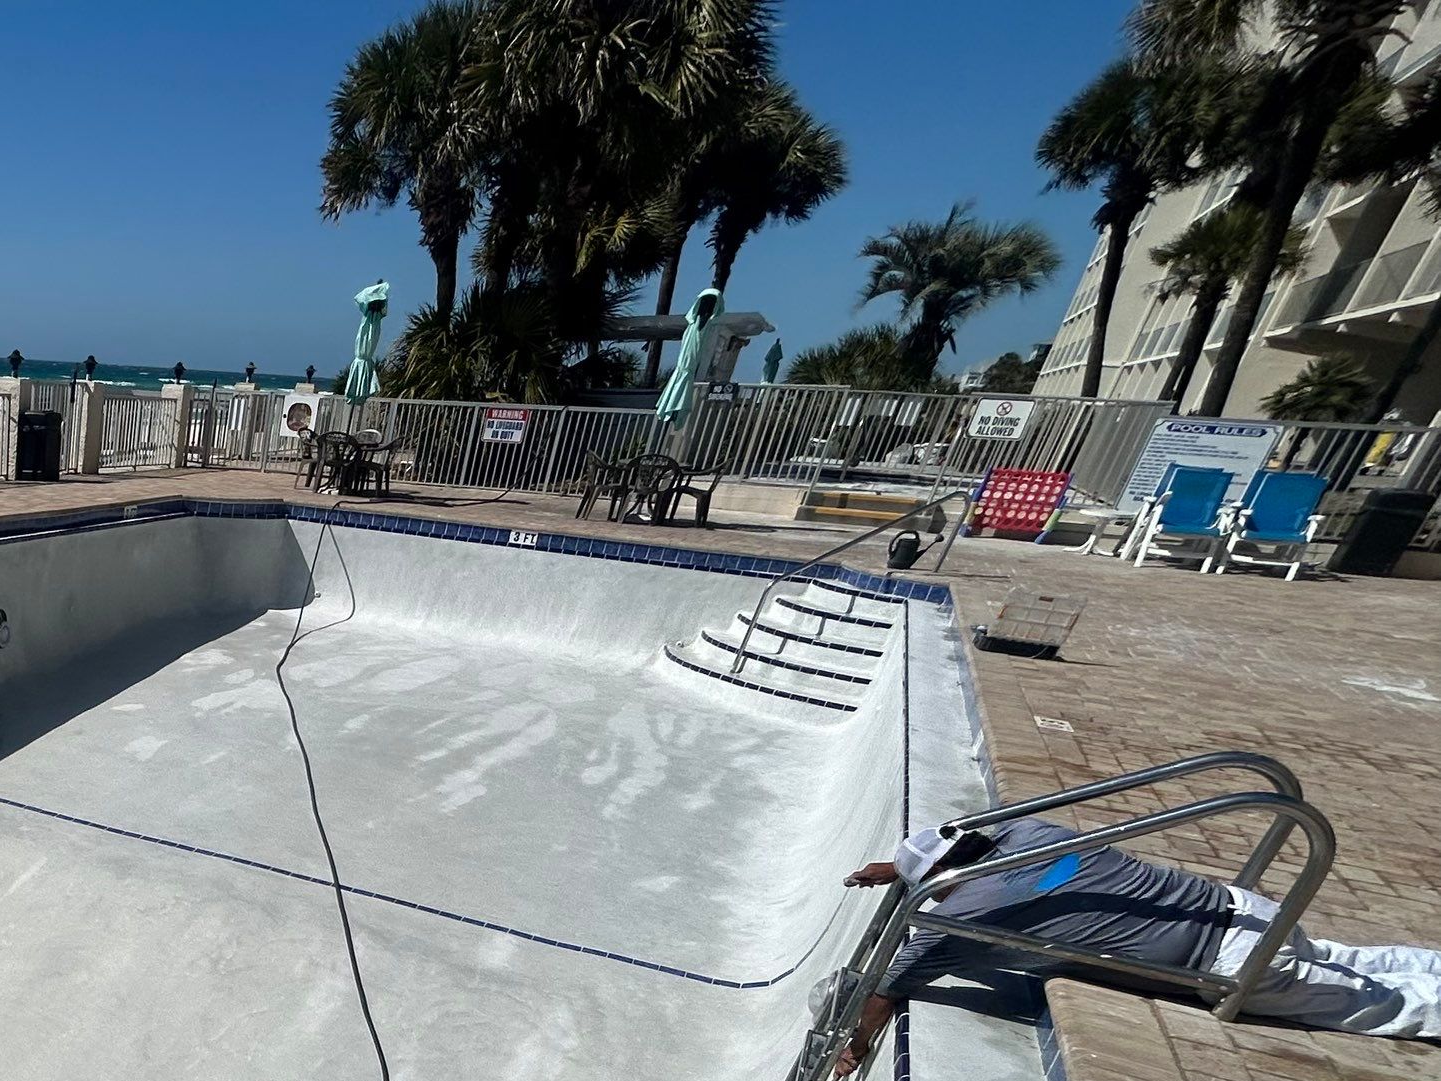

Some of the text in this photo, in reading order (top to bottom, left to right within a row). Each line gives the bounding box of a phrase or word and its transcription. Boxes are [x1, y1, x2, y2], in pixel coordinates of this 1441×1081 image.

[491, 409, 525, 419] WARNING
[487, 420, 495, 429] NO
[978, 415, 1021, 427] NO DIVING
[975, 426, 1014, 436] ALLOWED
[1170, 423, 1265, 437] POOL RULES
[513, 531, 521, 542] 3
